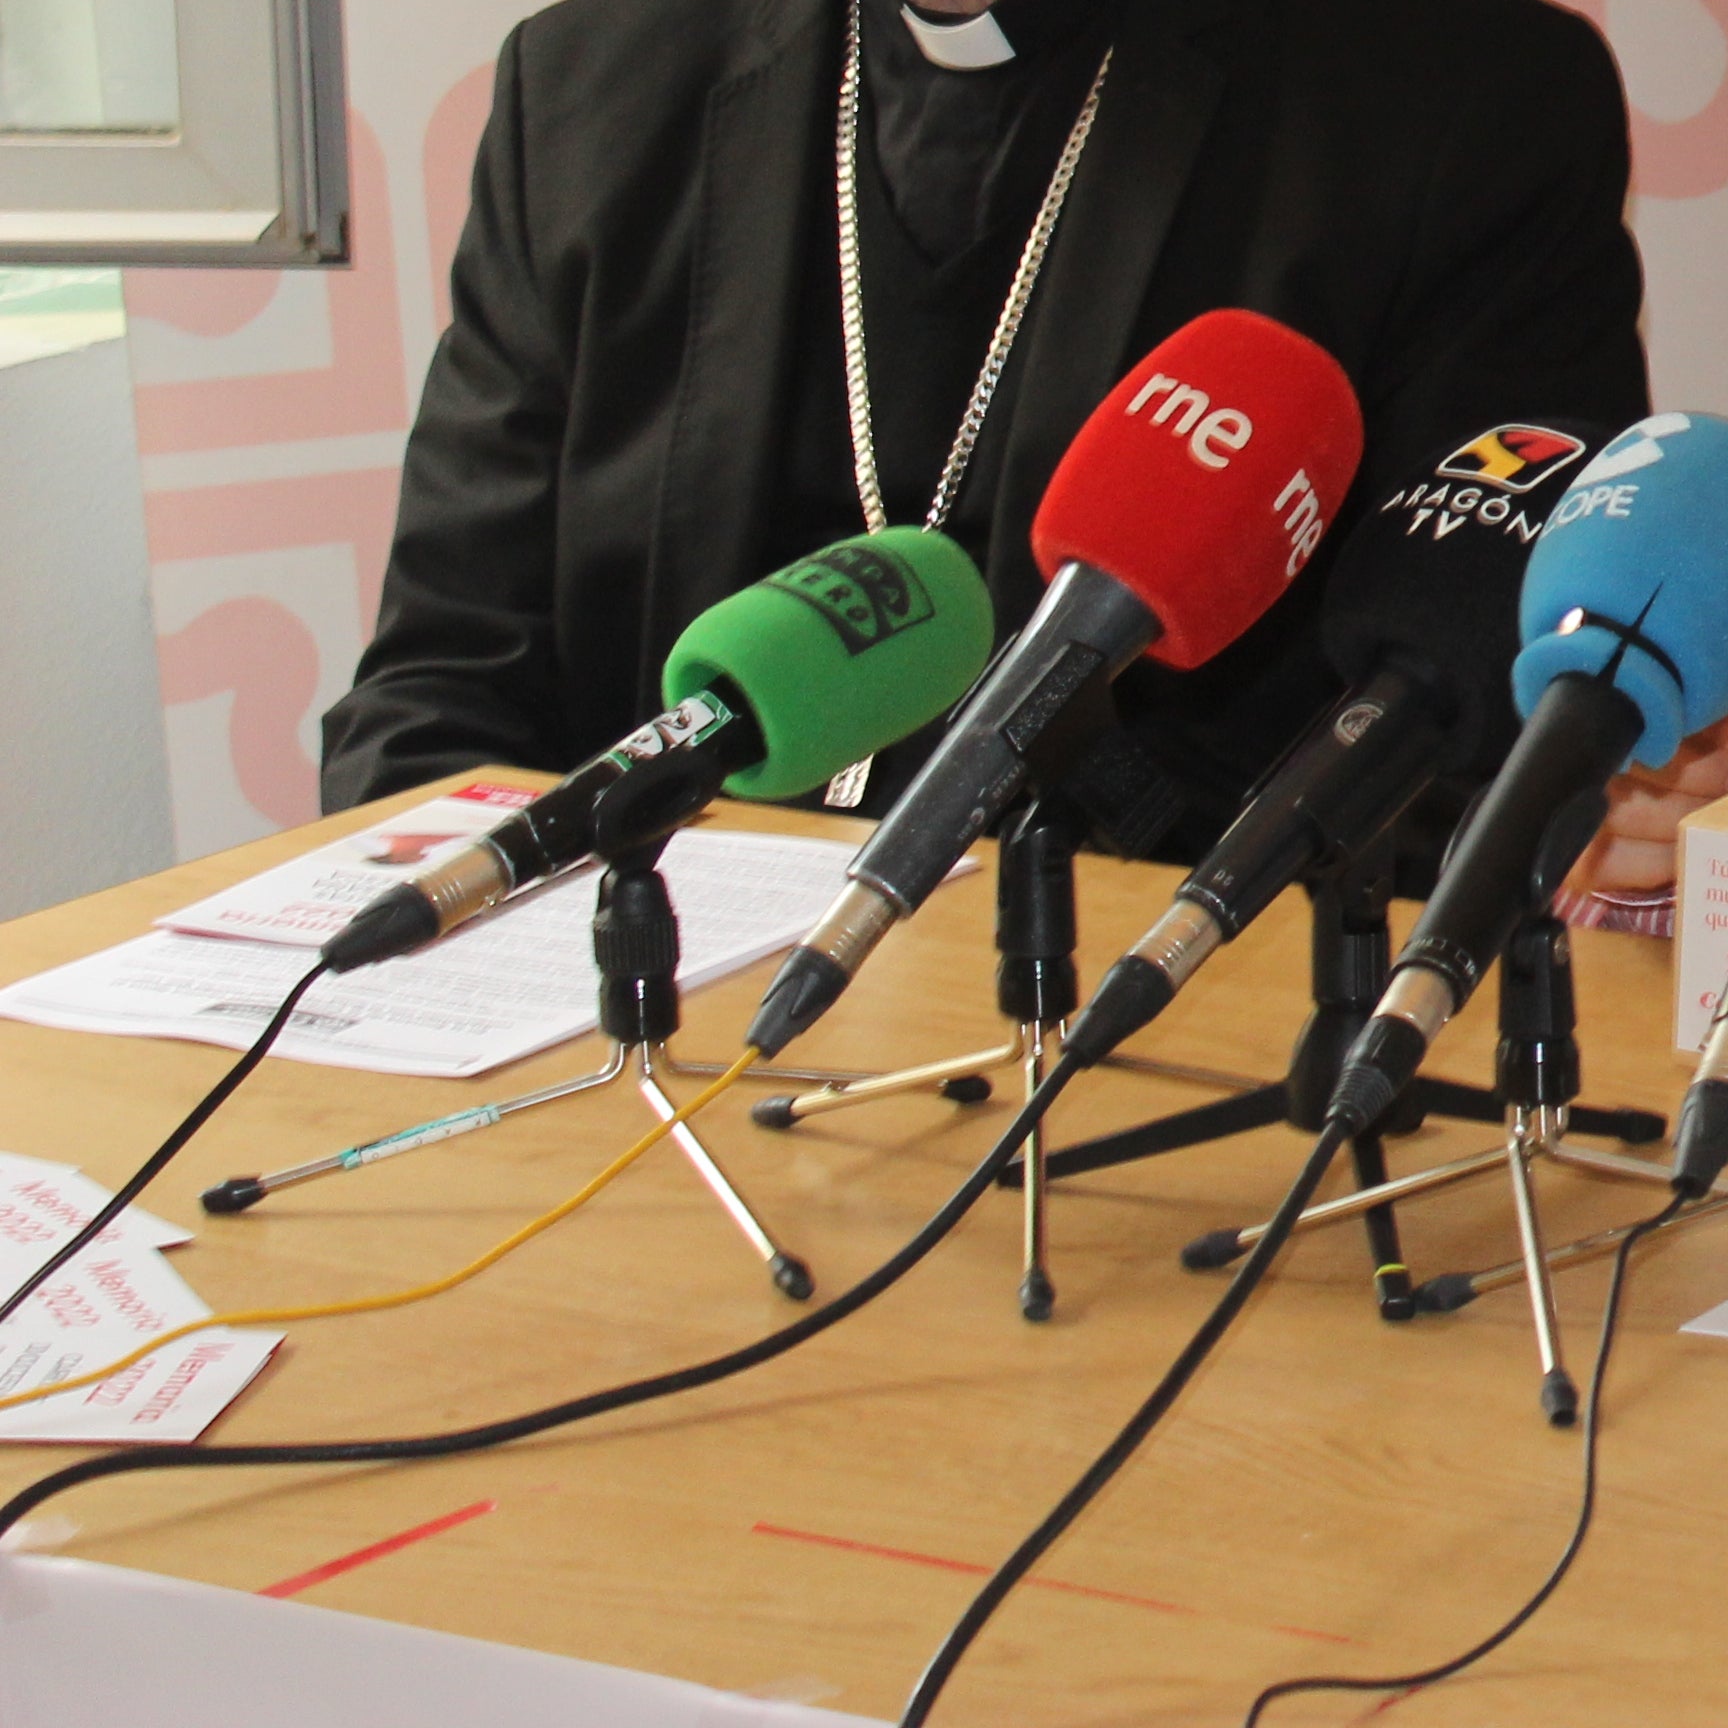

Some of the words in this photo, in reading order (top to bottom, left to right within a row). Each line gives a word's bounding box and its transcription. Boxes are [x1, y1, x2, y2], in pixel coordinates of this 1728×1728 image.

[1124, 371, 1254, 470] rne
[1272, 467, 1324, 578] rne
[1380, 481, 1543, 544] ARAGÓN
[1405, 507, 1469, 541] TV
